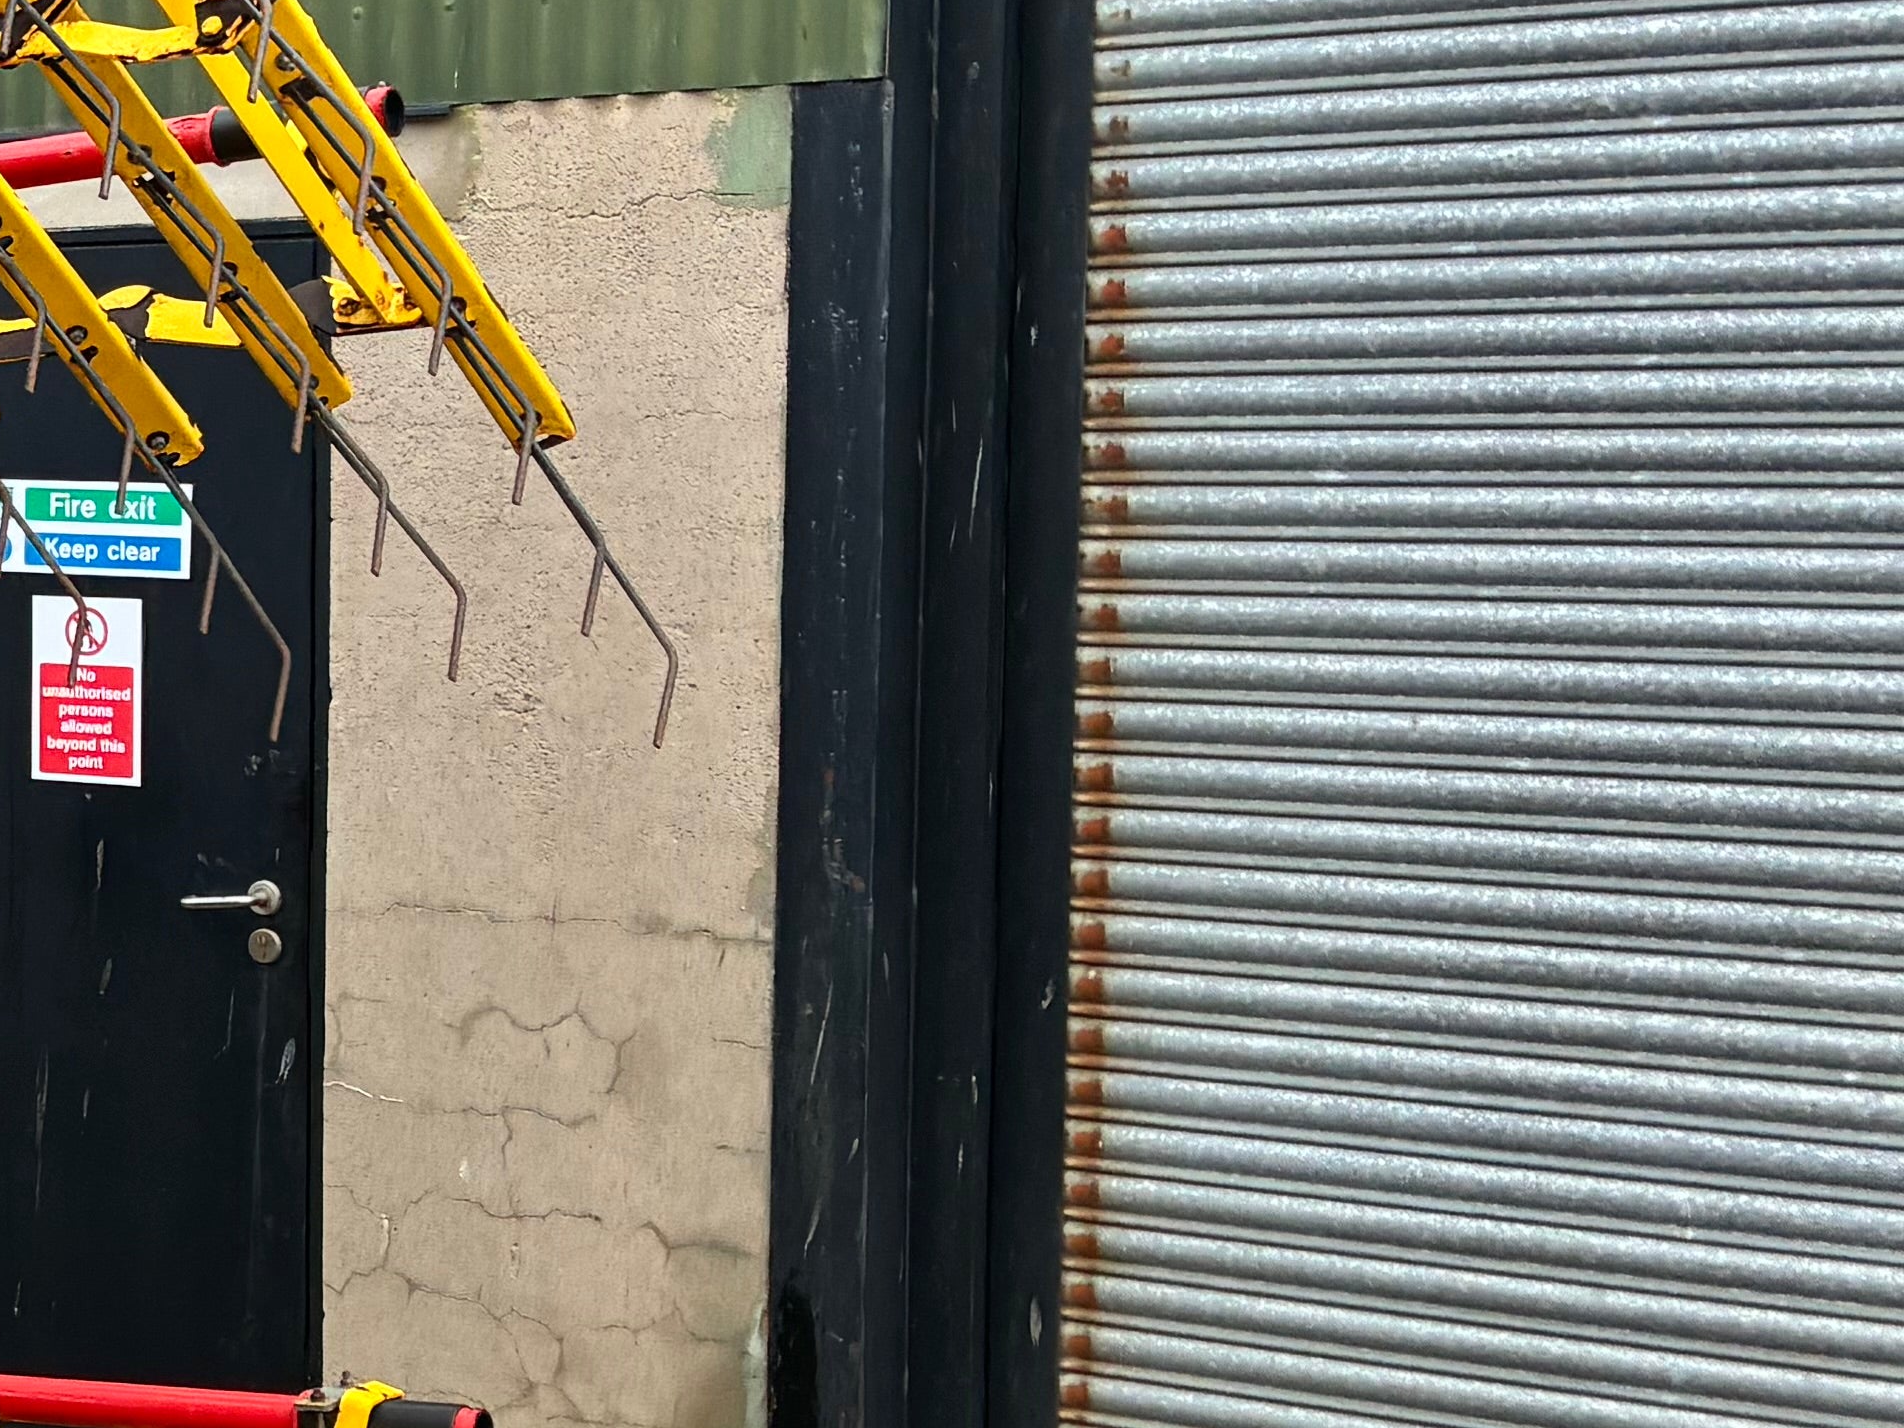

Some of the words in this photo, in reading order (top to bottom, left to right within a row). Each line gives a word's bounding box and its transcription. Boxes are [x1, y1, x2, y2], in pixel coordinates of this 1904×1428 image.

[49, 492, 97, 519] Fire
[108, 495, 157, 521] exit
[44, 537, 98, 563] Keep
[107, 540, 161, 562] clear
[76, 667, 97, 682] No
[42, 684, 132, 701] unauthorised
[58, 703, 114, 719] persons
[60, 718, 113, 735] allowed
[46, 734, 97, 753] beyond
[99, 738, 127, 754] this
[67, 754, 104, 771] point
